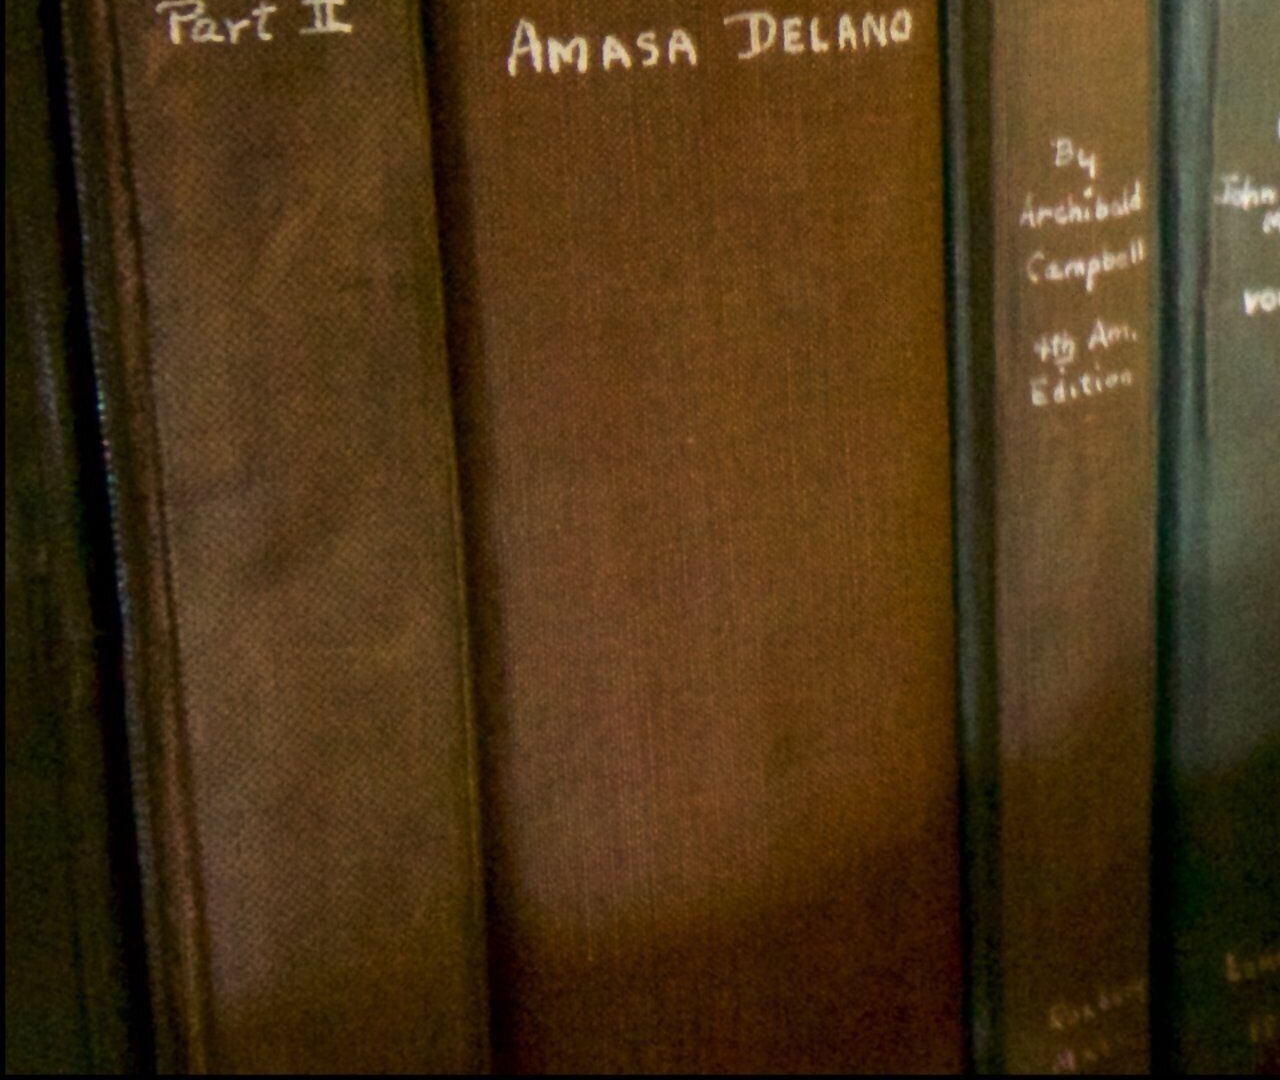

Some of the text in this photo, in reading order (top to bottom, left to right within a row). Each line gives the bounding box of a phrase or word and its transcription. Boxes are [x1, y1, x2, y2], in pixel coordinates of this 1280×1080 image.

[156, 0, 278, 46] Part
[507, 9, 913, 78] AMASA DELANO
[1051, 137, 1096, 179] By
[1019, 181, 1141, 228] Archibald
[1214, 172, 1276, 210] John
[1027, 240, 1143, 292] Campbell
[1034, 332, 1075, 370] 4th
[1031, 364, 1133, 406] Edition
